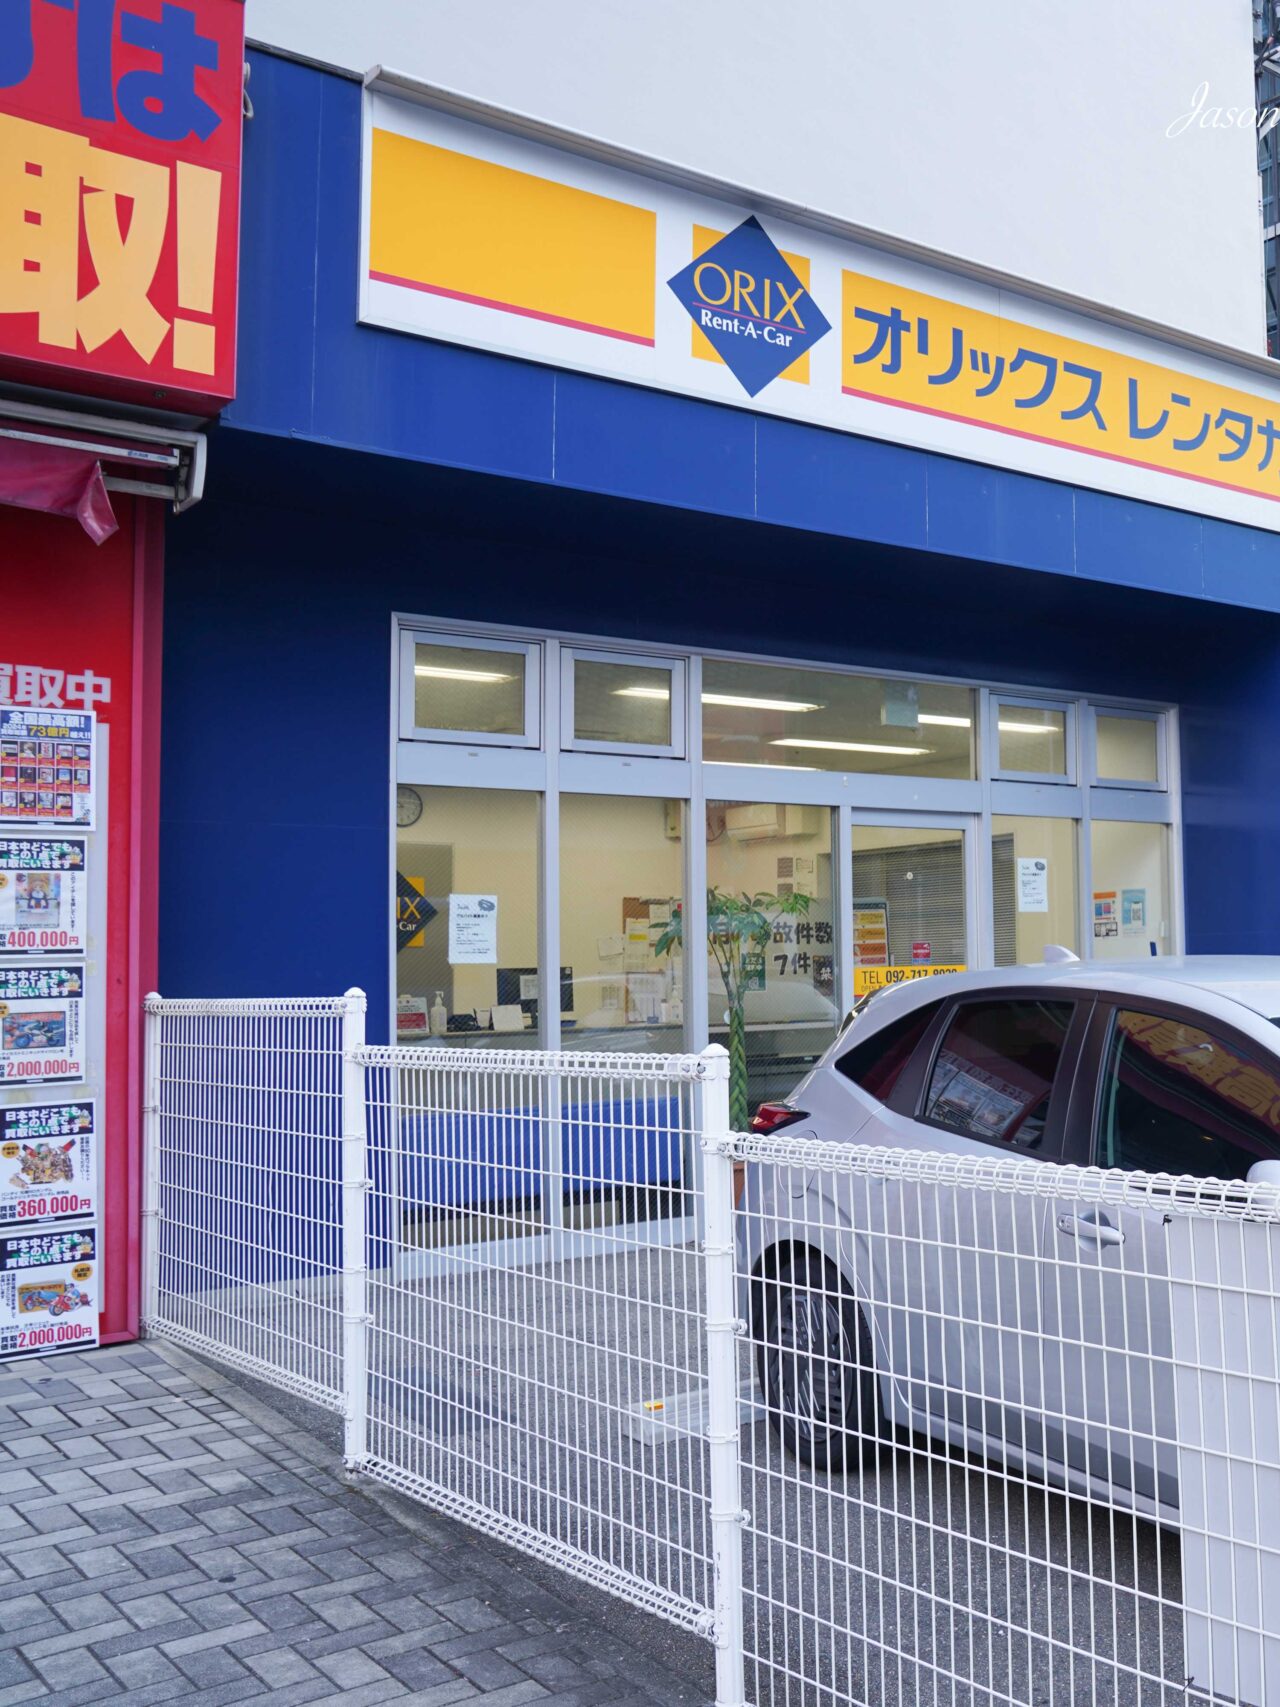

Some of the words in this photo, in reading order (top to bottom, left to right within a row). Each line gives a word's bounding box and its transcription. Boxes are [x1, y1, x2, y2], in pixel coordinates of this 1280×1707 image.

[0, 0, 222, 142] は
[693, 262, 805, 329] ORIX
[700, 308, 793, 348] Rent-A-Car
[852, 306, 1107, 432] オリックス
[861, 971, 883, 984] TEL
